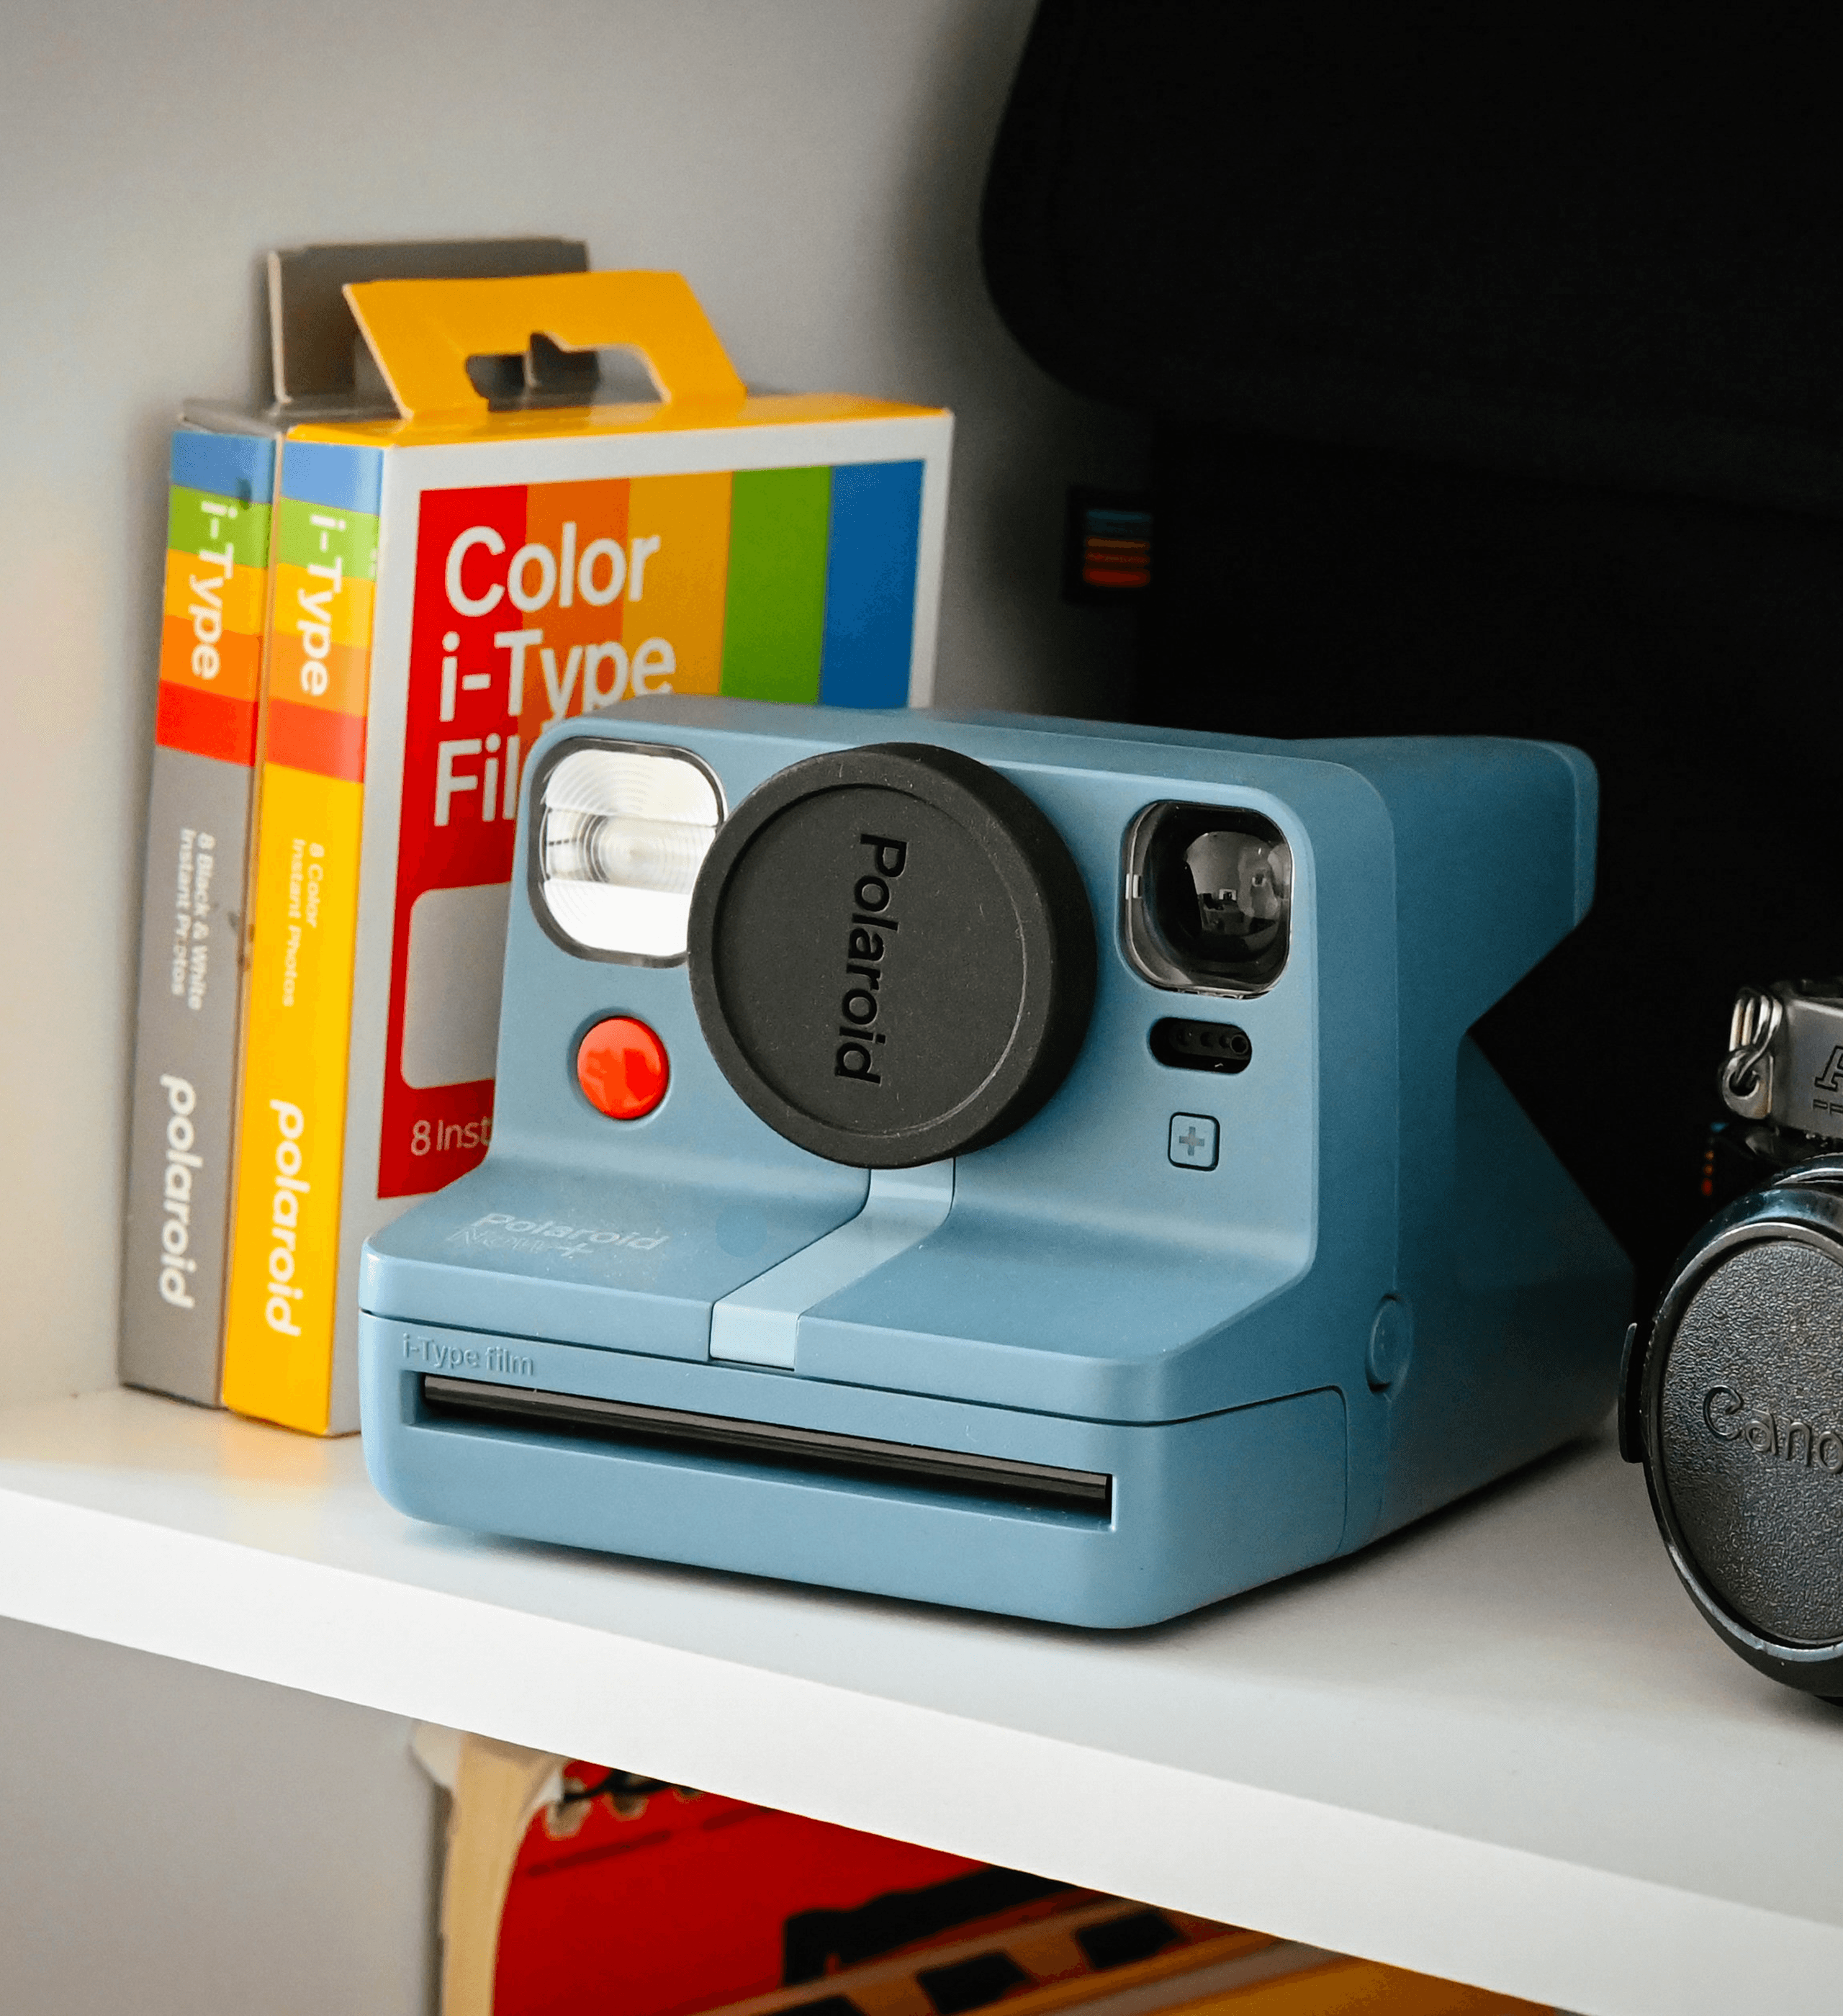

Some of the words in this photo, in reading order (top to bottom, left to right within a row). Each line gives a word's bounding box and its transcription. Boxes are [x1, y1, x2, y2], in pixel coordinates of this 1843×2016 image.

[189, 500, 238, 680] i-Type
[445, 521, 661, 617] Color
[297, 514, 347, 696] i-Type
[439, 629, 676, 733] i-Type
[176, 827, 197, 910] Instant
[198, 832, 216, 850] 8
[308, 842, 325, 858] 8
[193, 852, 215, 919] Black
[287, 837, 307, 919] Instant
[305, 863, 324, 928] Color
[192, 921, 209, 939] &
[834, 833, 908, 1085] Polaroid
[189, 945, 208, 1010] White
[281, 924, 302, 1008] Photos
[410, 1120, 431, 1156] 8
[470, 1213, 670, 1250] Polaroid
[402, 1333, 480, 1368] i-Type
[485, 1346, 534, 1376] film
